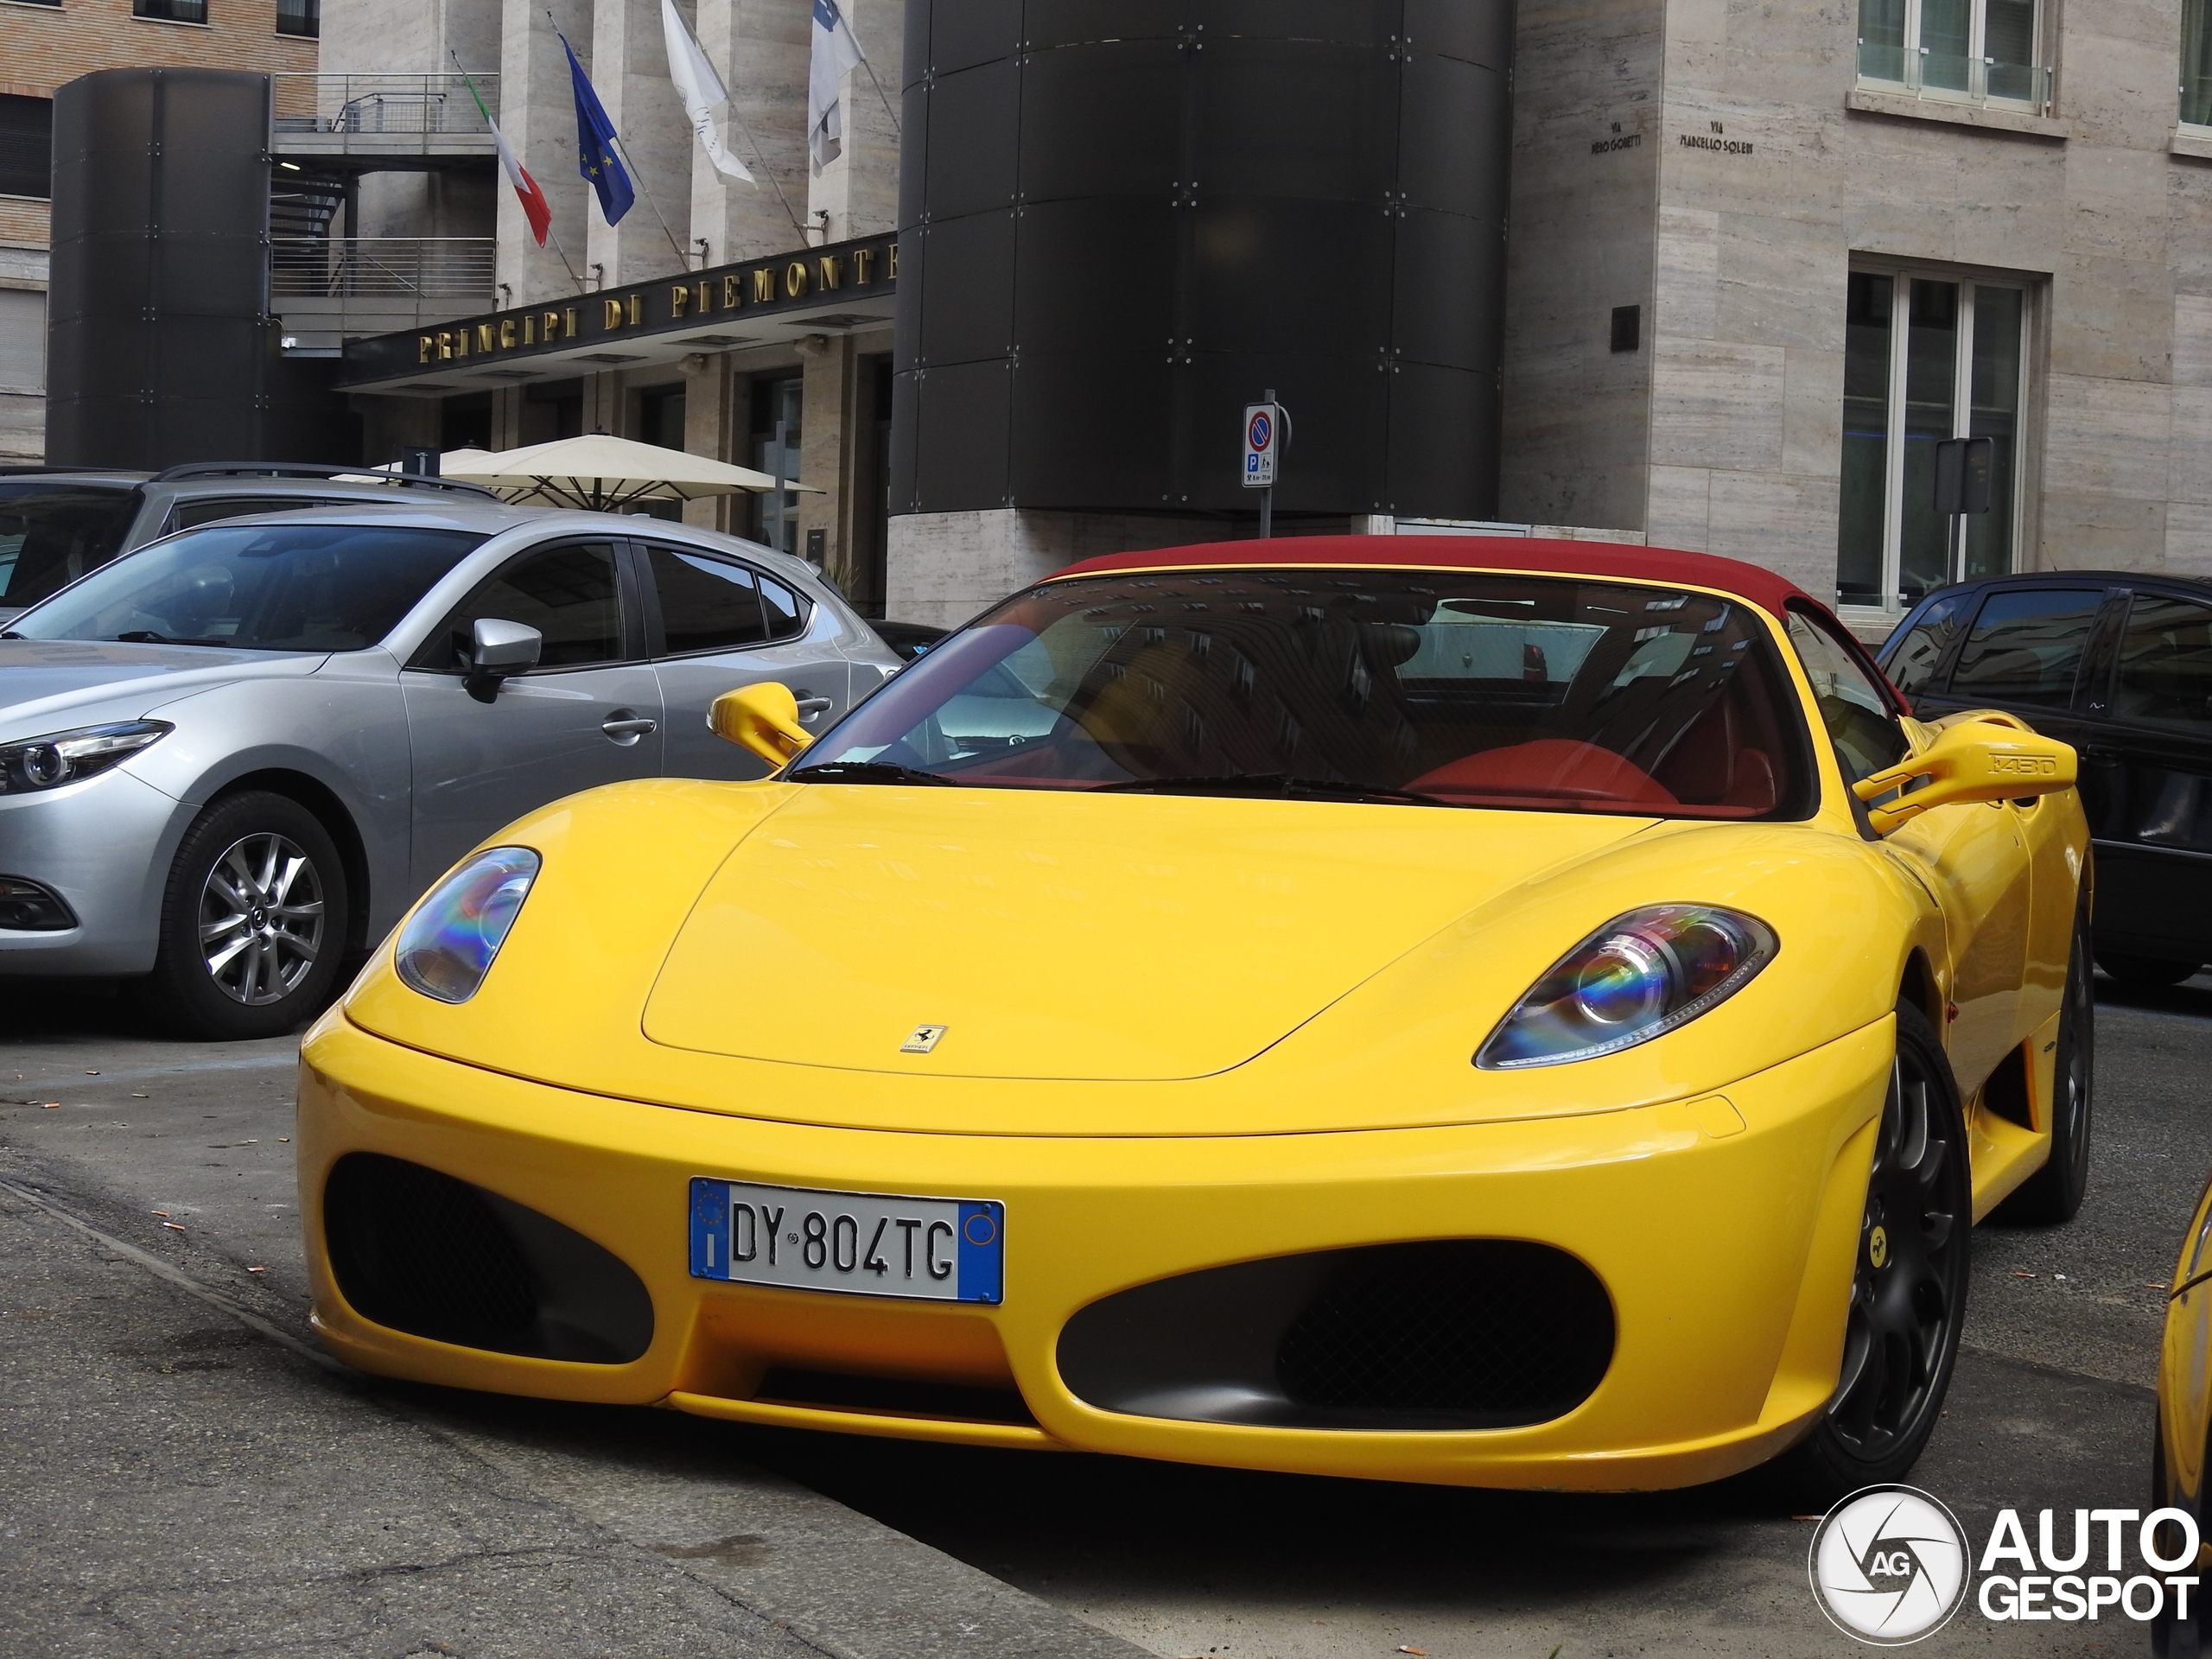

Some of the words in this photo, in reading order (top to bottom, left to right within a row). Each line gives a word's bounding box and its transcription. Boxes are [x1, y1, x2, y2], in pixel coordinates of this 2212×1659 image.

[1710, 120, 1724, 135] VIA
[1680, 134, 1722, 151] MARCELLO
[418, 307, 578, 364] PRINCIPI
[603, 293, 643, 332] DI
[1987, 752, 2057, 776] F430
